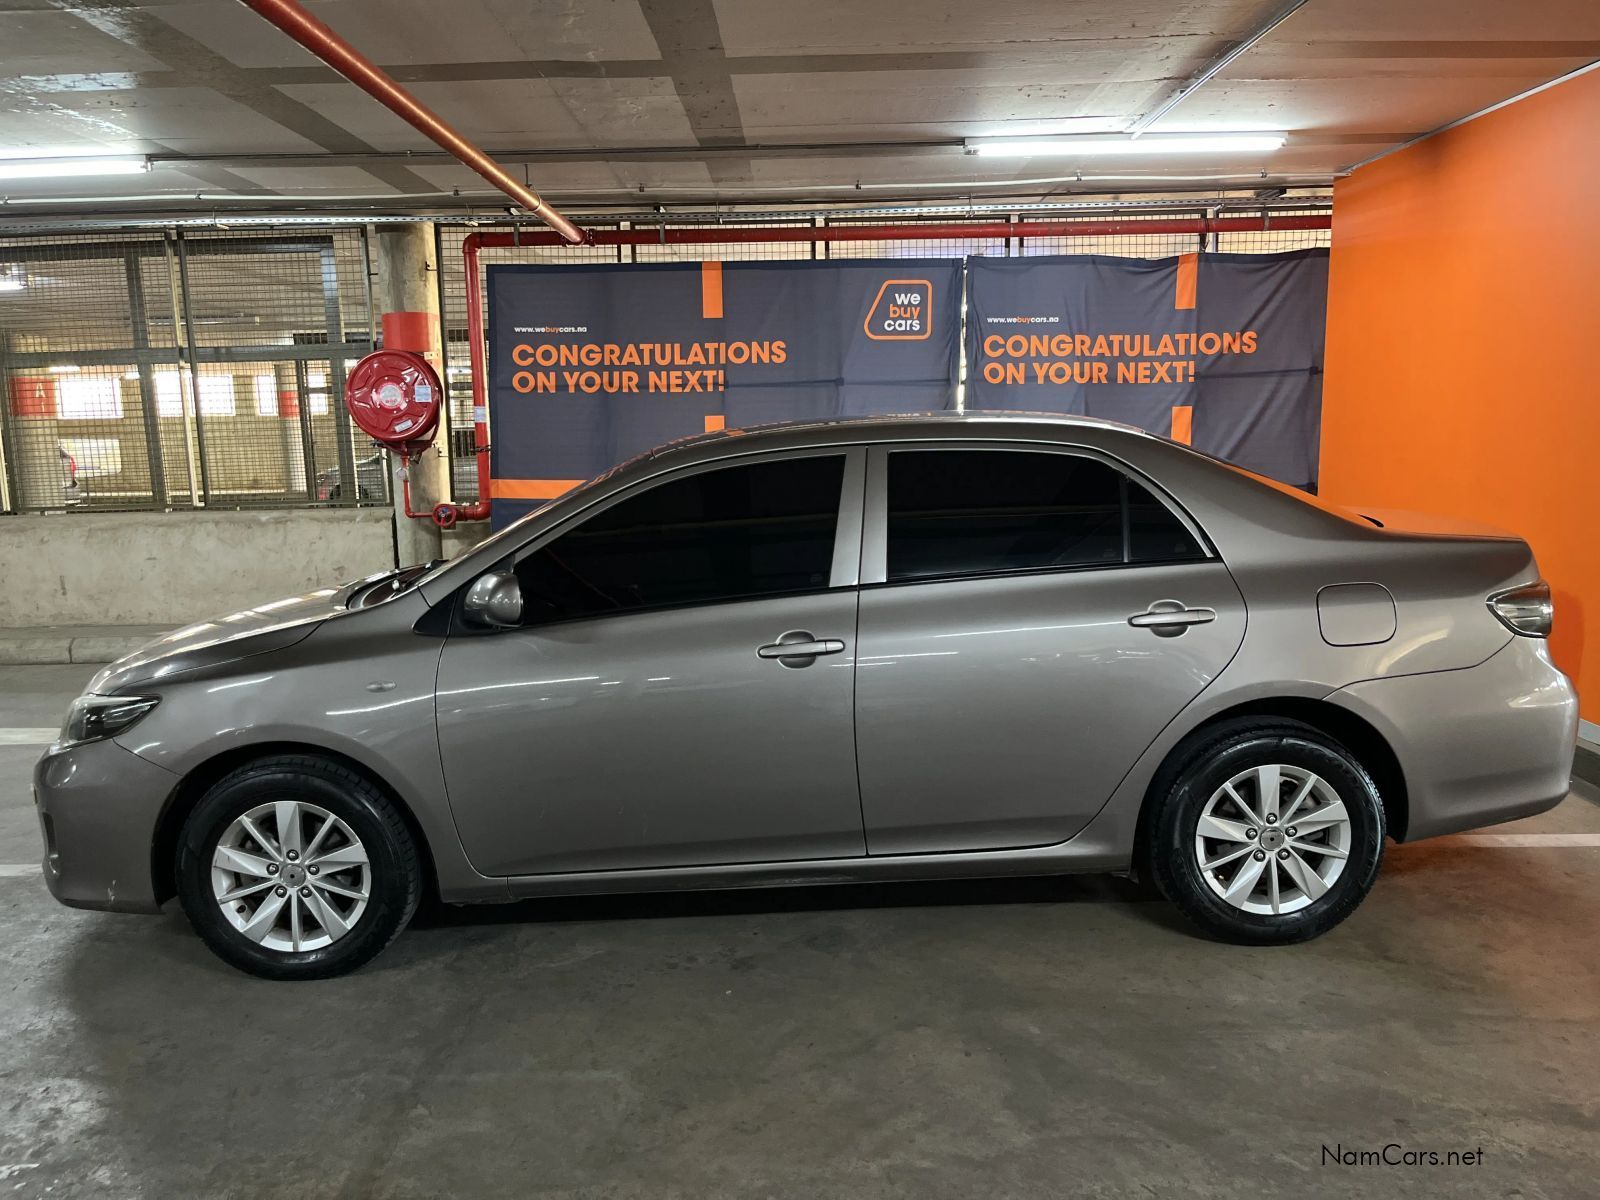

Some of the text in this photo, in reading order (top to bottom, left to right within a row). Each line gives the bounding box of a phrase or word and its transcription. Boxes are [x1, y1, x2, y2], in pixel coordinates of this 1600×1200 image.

[895, 293, 921, 305] we
[889, 304, 920, 320] buy
[986, 315, 1059, 325] www.webuycars.na
[514, 326, 588, 334] www.webuycars.na
[884, 319, 921, 331] cars
[983, 330, 1258, 358] CONGRATULATIONS
[512, 340, 788, 367] CONGRATULATIONS
[983, 360, 1196, 385] ON YOUR NEXT!
[512, 369, 726, 394] ON YOUR NEXT!
